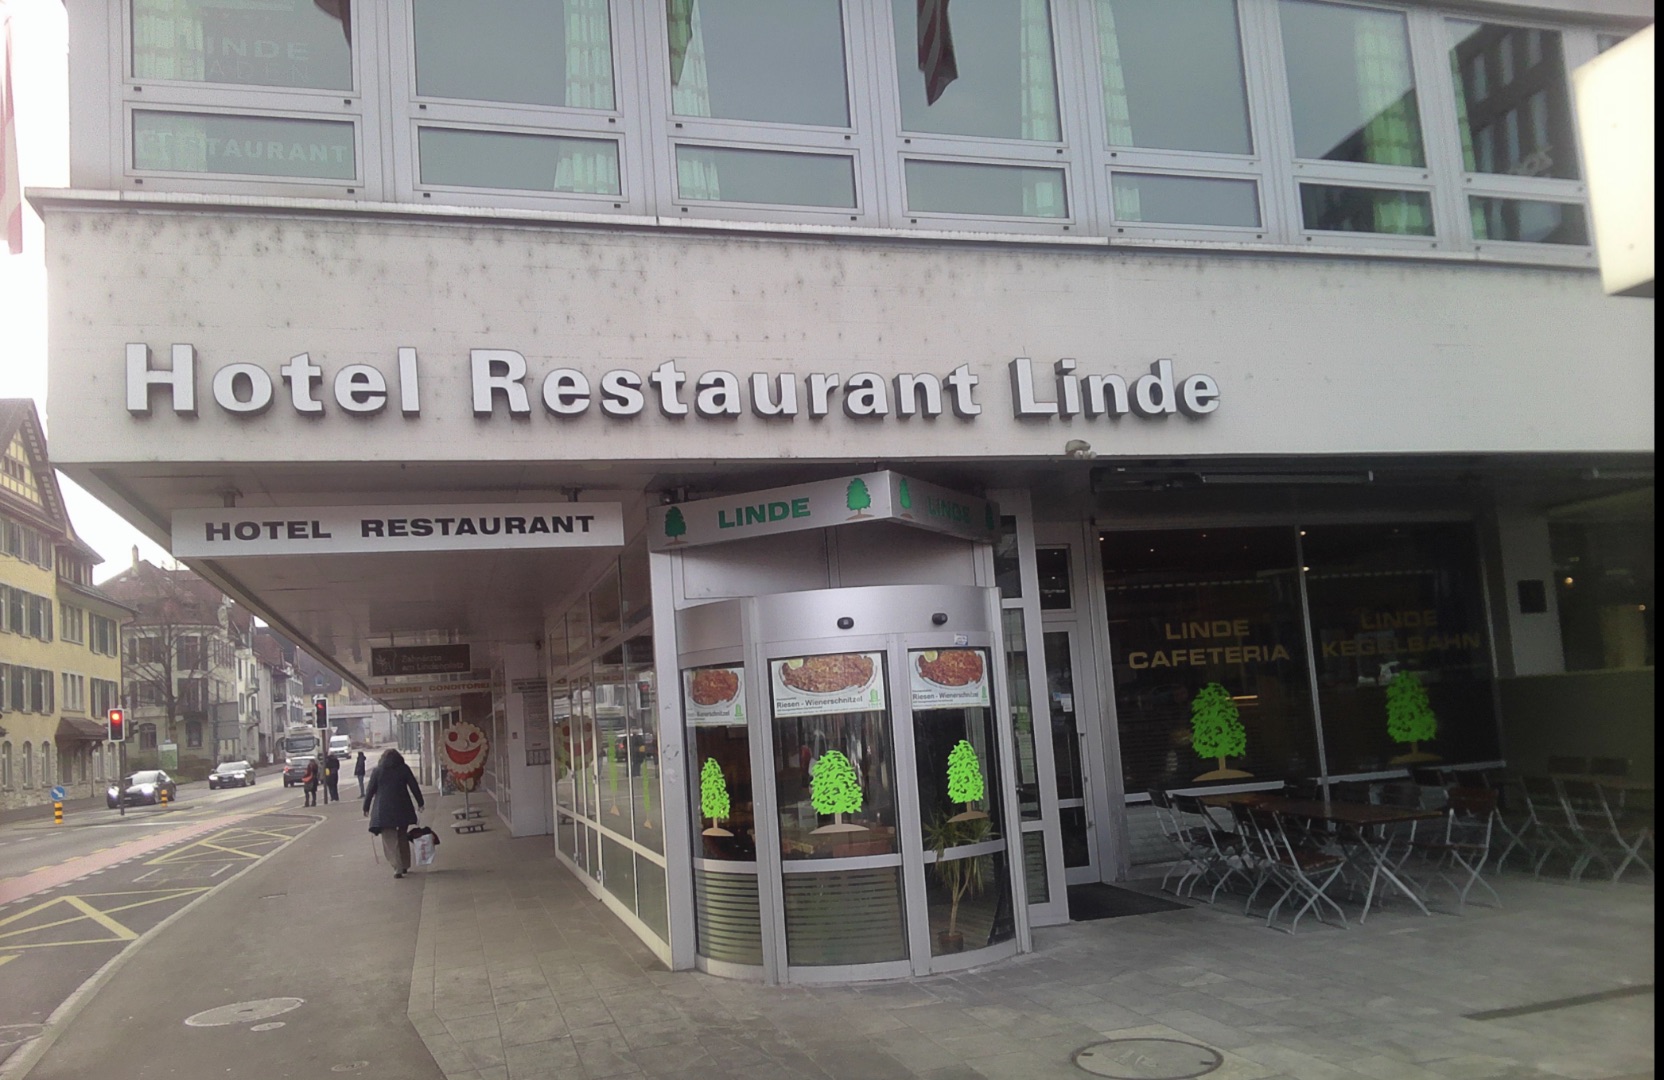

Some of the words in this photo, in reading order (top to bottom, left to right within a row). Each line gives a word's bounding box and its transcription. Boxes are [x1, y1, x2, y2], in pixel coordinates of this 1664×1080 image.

[125, 342, 420, 418] Hotel
[470, 348, 982, 419] Restaurant
[1008, 357, 1221, 421] Linde
[717, 497, 811, 529] LINDE
[927, 496, 971, 524] LINDE
[205, 519, 332, 542] HOTEL
[360, 515, 595, 539] RESTAURANT
[1165, 619, 1250, 640] LINDE
[1361, 609, 1438, 630] LINDE
[1128, 644, 1290, 669] CAFETERIA
[1322, 632, 1481, 657] KEGELBAHN
[371, 686, 422, 695] BÄCKEREI
[428, 682, 490, 692] CONDITOREI
[776, 701, 800, 709] Riesen
[805, 695, 863, 706] Wienerschnitzel
